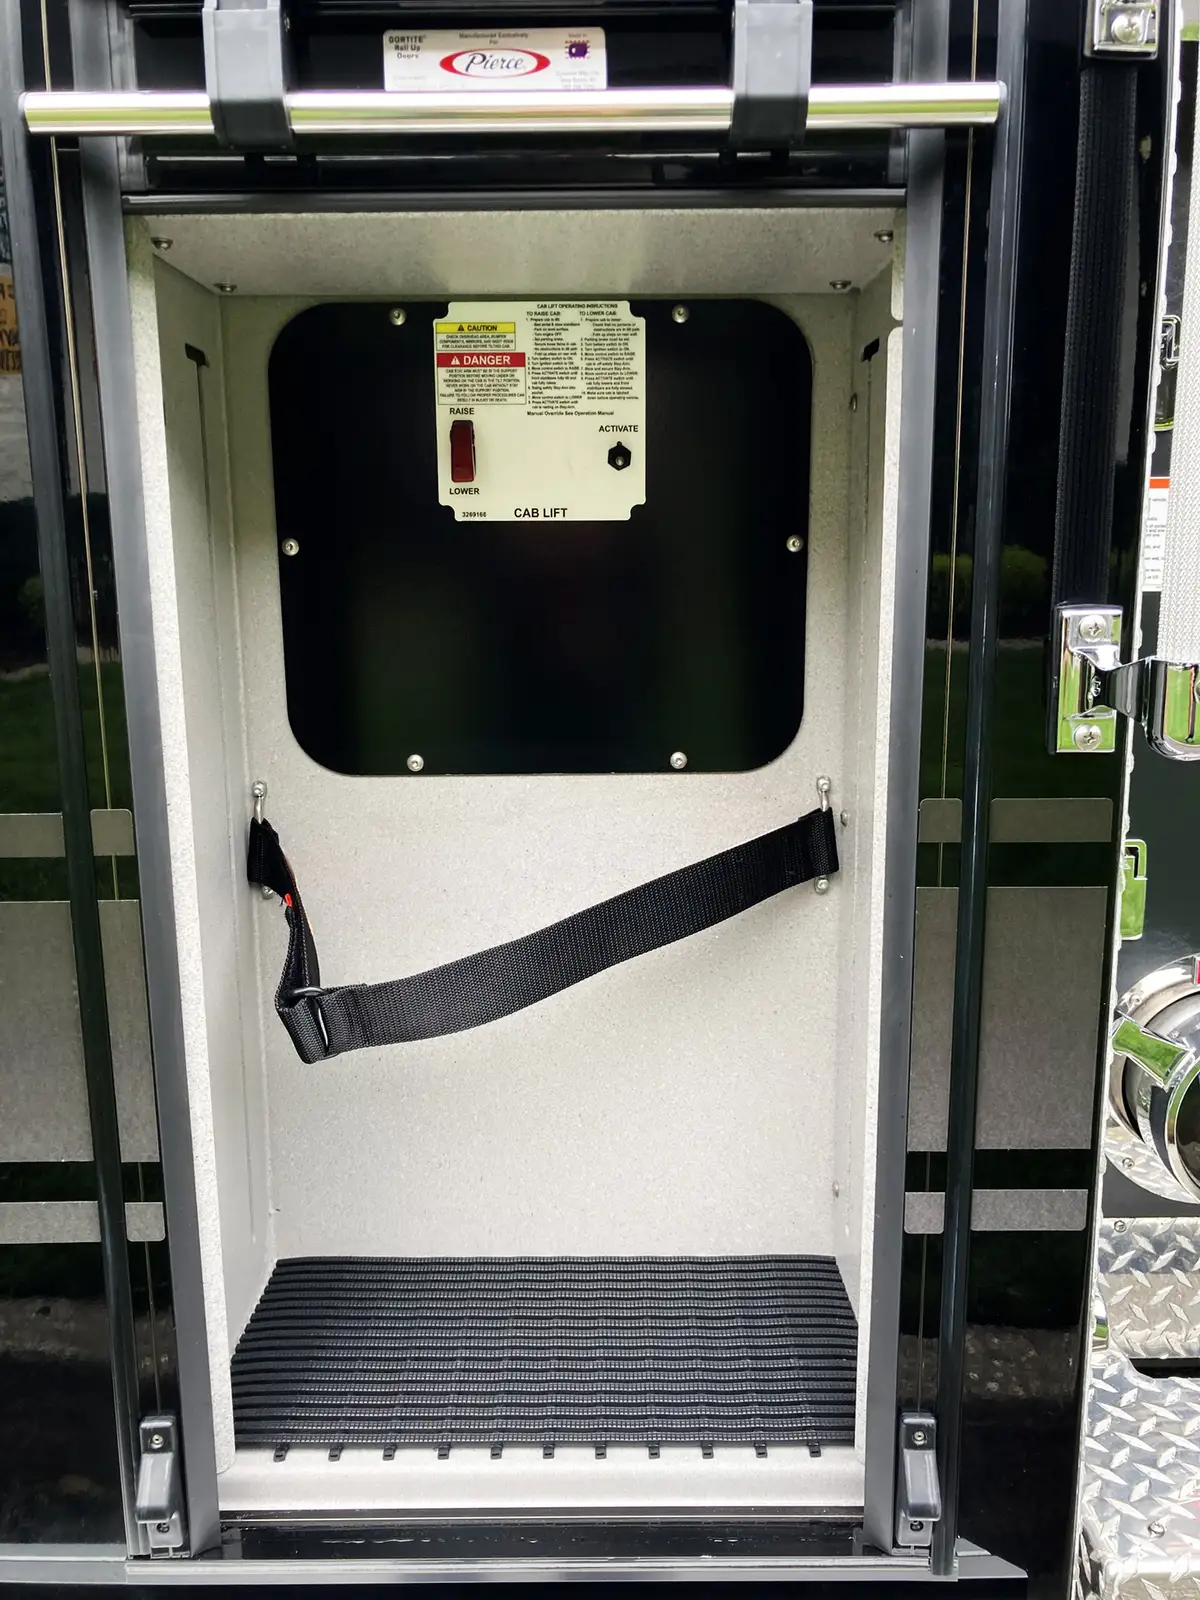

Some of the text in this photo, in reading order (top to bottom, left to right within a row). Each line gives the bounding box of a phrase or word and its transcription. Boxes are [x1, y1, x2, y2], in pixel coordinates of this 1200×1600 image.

[465, 52, 524, 73] Pierce
[463, 355, 511, 365] DANGER
[449, 407, 474, 415] RAISE
[598, 425, 639, 433] ACTIVATE
[449, 487, 480, 495] LOWER
[514, 508, 539, 518] CAB
[543, 508, 568, 518] LIFT
